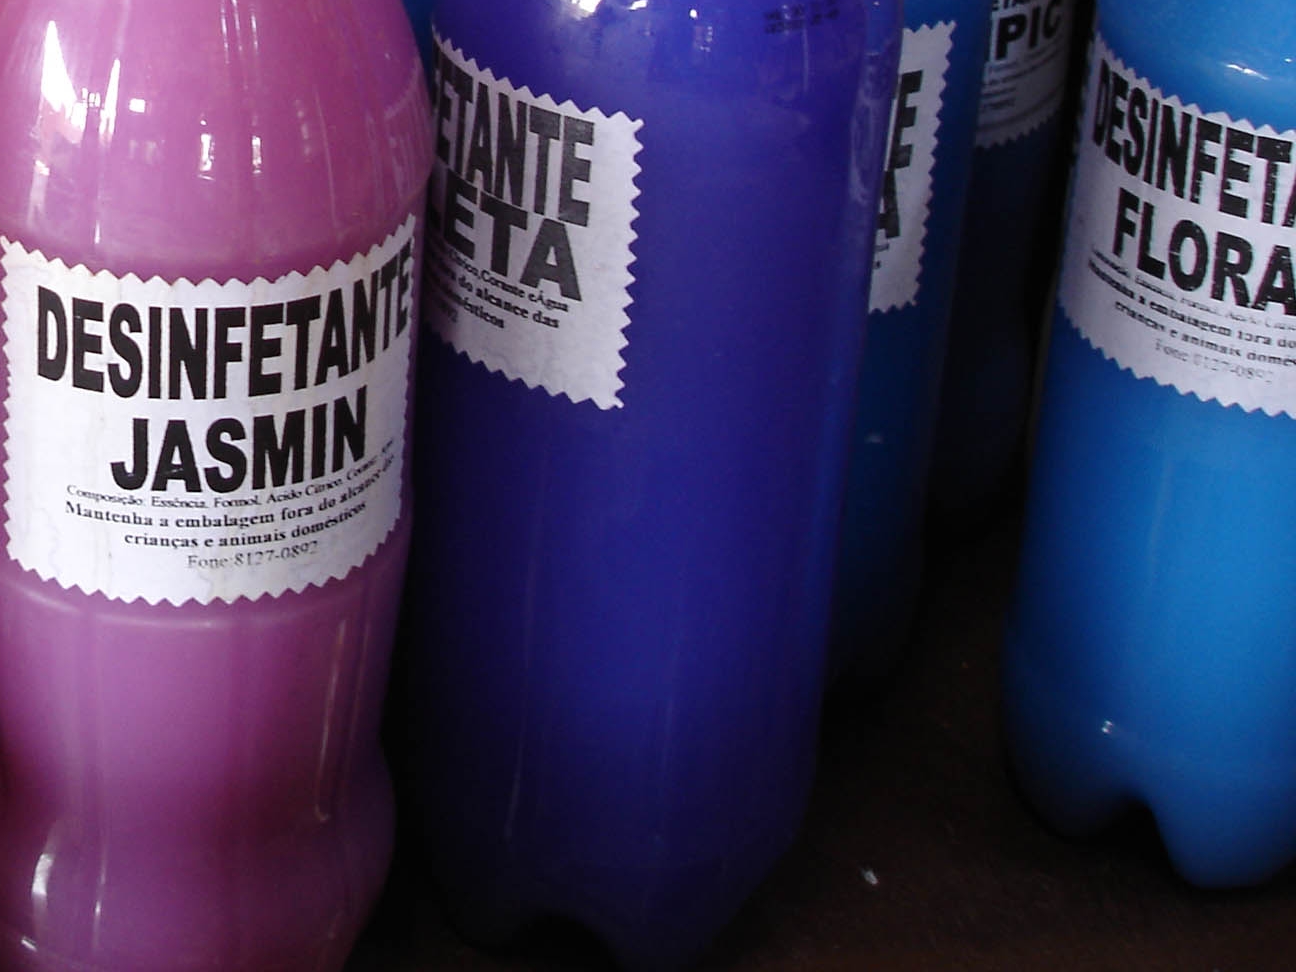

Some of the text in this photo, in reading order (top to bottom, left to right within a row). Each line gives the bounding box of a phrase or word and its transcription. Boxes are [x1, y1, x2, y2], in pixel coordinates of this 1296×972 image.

[37, 238, 413, 400] DESINFETANTE
[110, 385, 368, 493] JASMIN
[65, 501, 153, 526] Mantenha
[159, 517, 168, 526] a
[175, 513, 275, 529] embalagem
[281, 505, 313, 521] fora
[319, 498, 336, 512] do
[124, 532, 199, 549] crianças
[204, 538, 214, 547] e
[219, 528, 286, 547] animais
